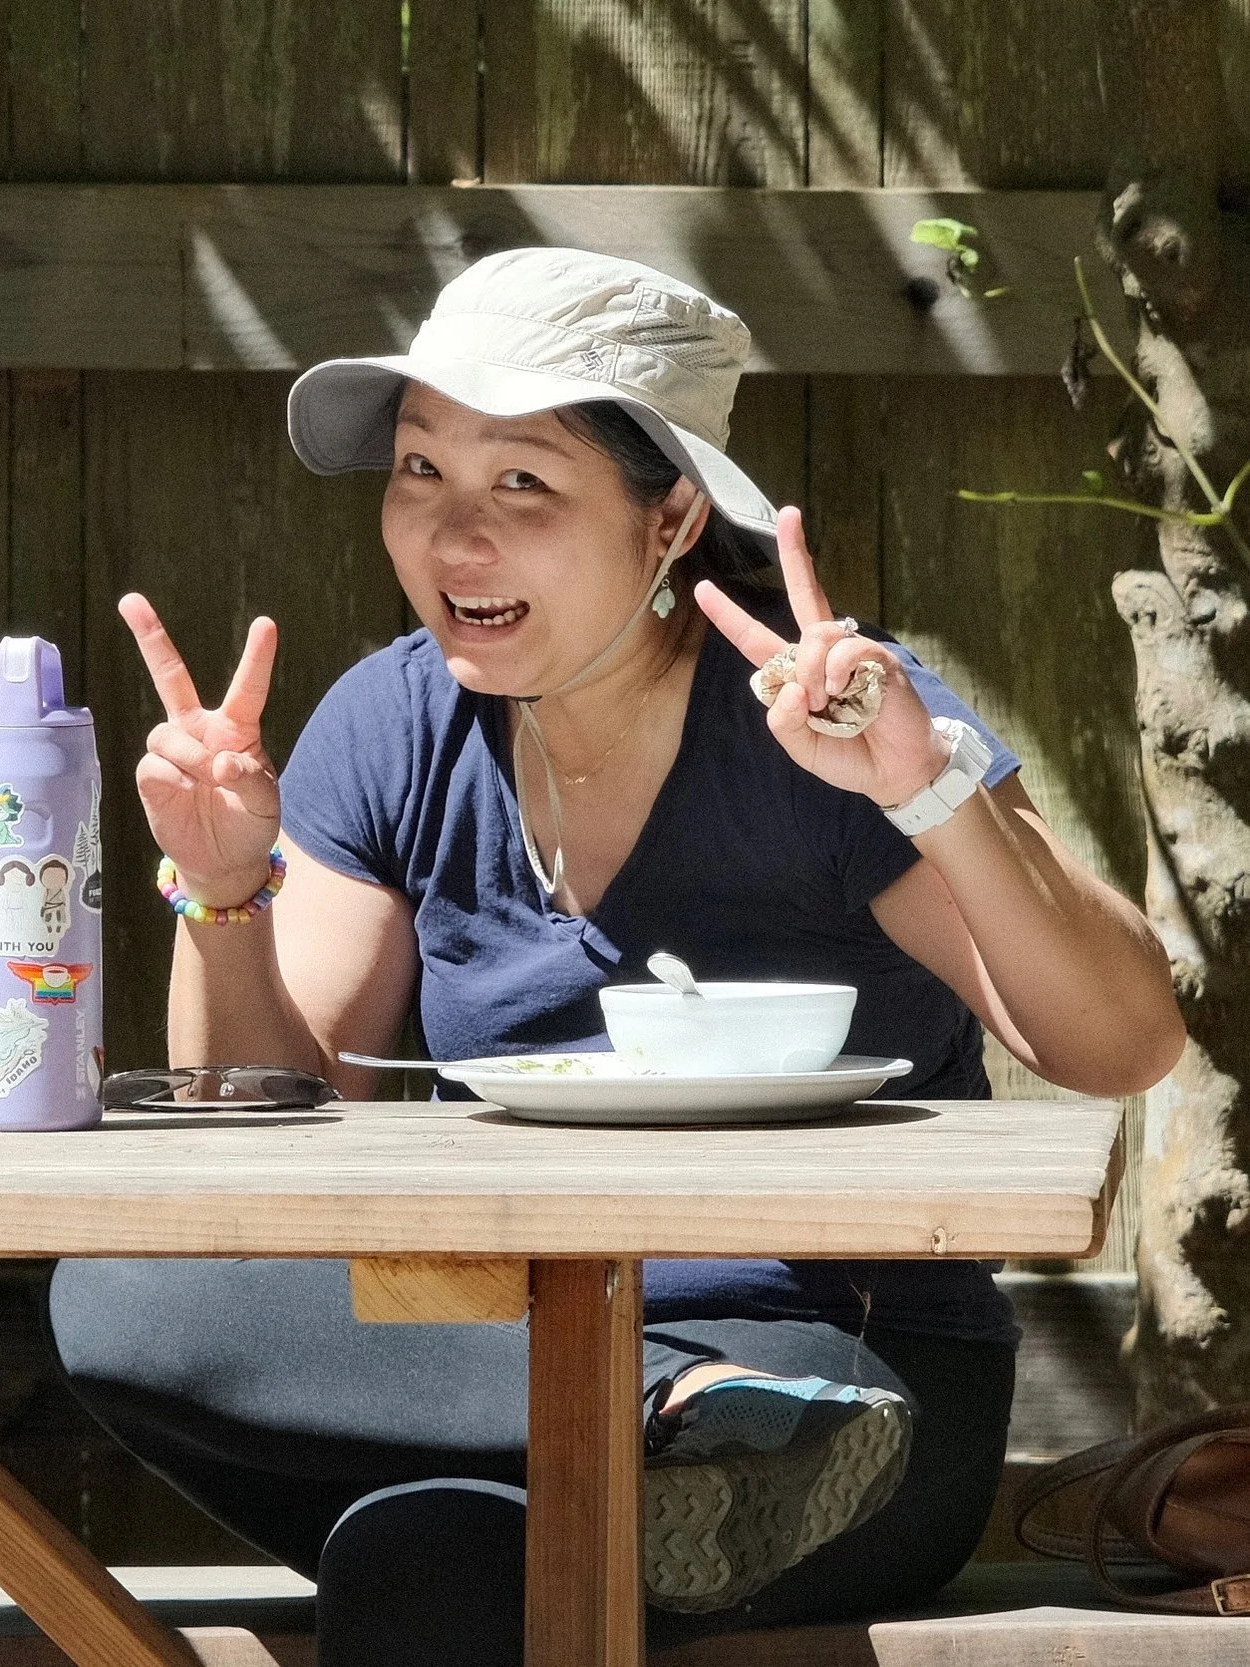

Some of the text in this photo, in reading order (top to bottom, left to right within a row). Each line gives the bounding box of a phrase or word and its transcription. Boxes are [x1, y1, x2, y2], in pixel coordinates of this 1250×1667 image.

[28, 942, 54, 951] YOU
[75, 1008, 85, 1084] STANLEY
[6, 1056, 37, 1084] IDAHO
